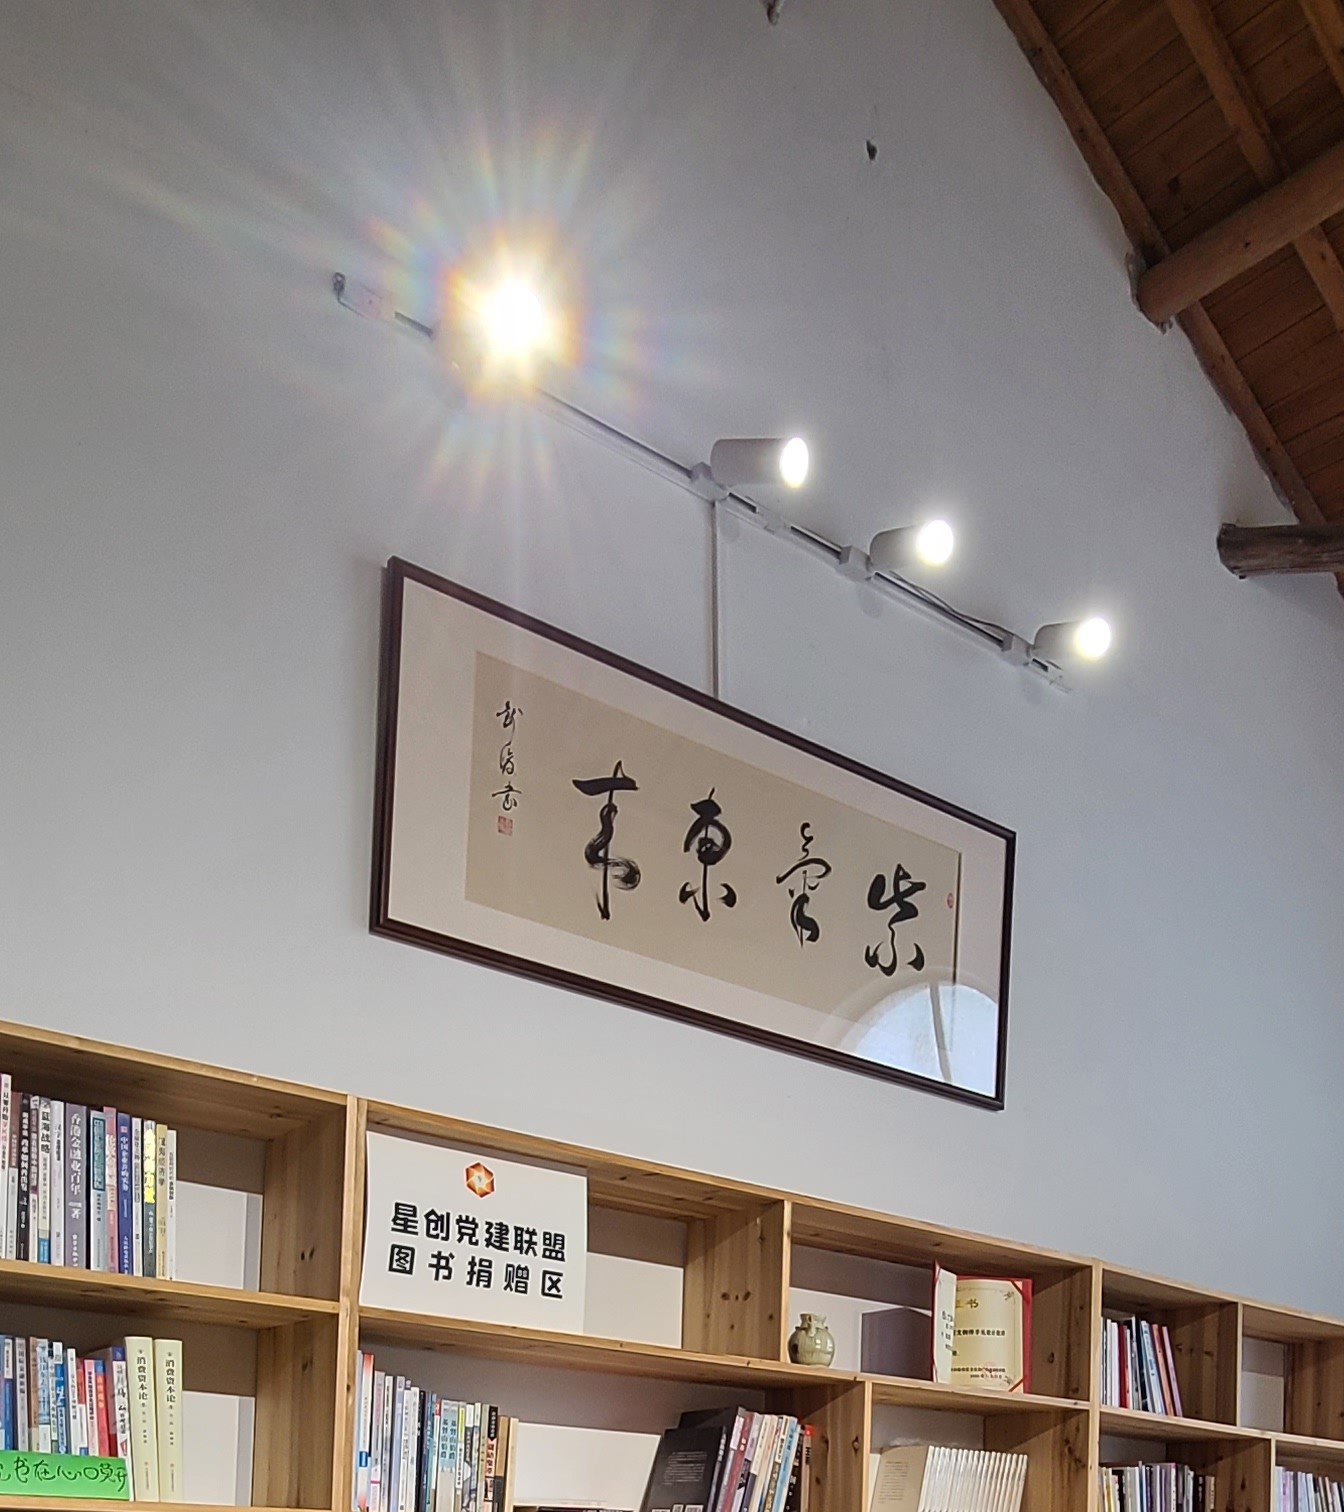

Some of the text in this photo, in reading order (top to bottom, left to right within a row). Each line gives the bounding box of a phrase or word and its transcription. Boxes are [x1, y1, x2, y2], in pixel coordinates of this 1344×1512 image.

[391, 1201, 566, 1263] 星创党建联盟
[388, 1243, 564, 1299] 图书捐赠区
[136, 1355, 149, 1400] 消费资本论
[164, 1358, 177, 1403] 消费资本论
